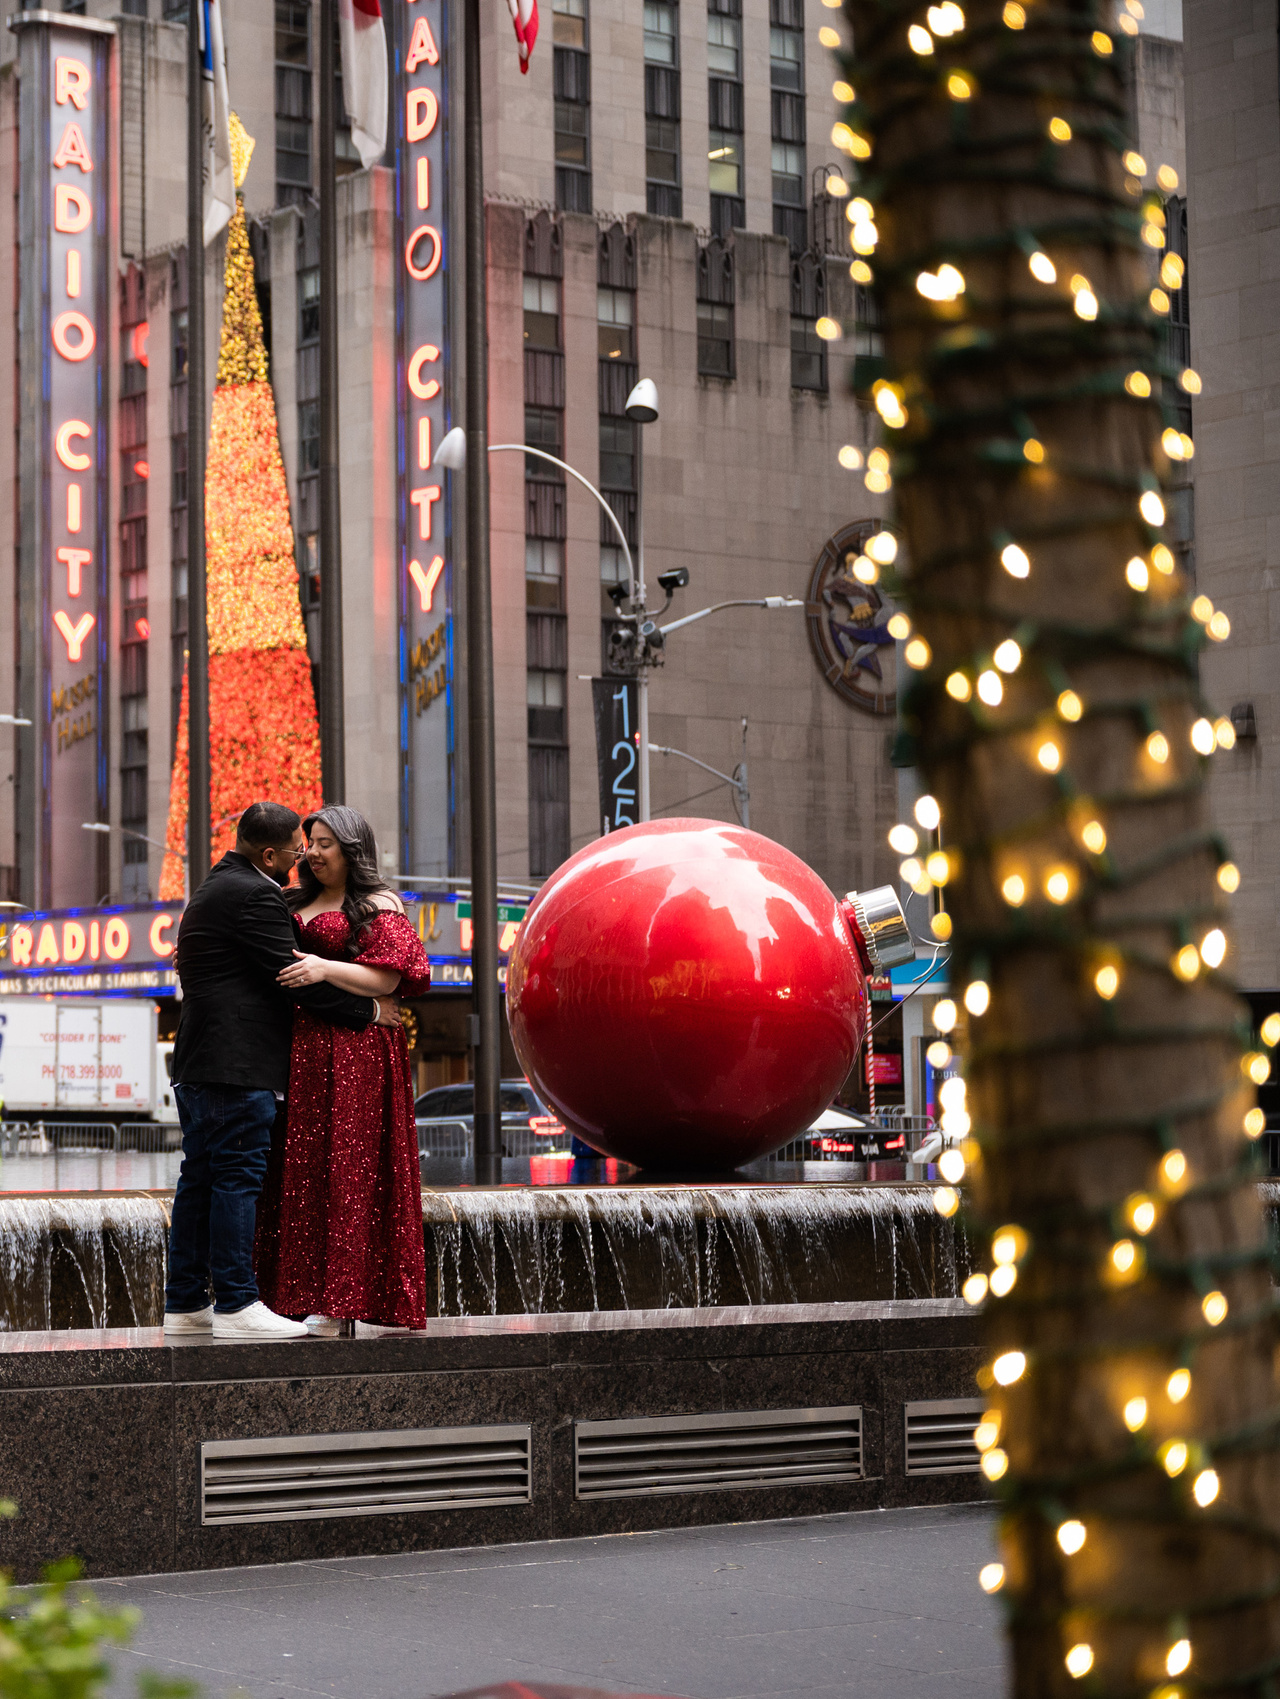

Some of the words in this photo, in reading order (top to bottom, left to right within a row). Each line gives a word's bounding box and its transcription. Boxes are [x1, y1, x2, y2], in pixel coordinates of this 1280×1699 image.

[51, 55, 97, 362] RADIO
[405, 0, 442, 281] ADIO
[53, 418, 96, 663] CITY
[408, 344, 444, 612] CITY
[11, 917, 130, 967] RADIO
[26, 974, 102, 993] SPECTACULAR
[106, 970, 159, 989] STARRING
[40, 1033, 84, 1043] "COSIDER
